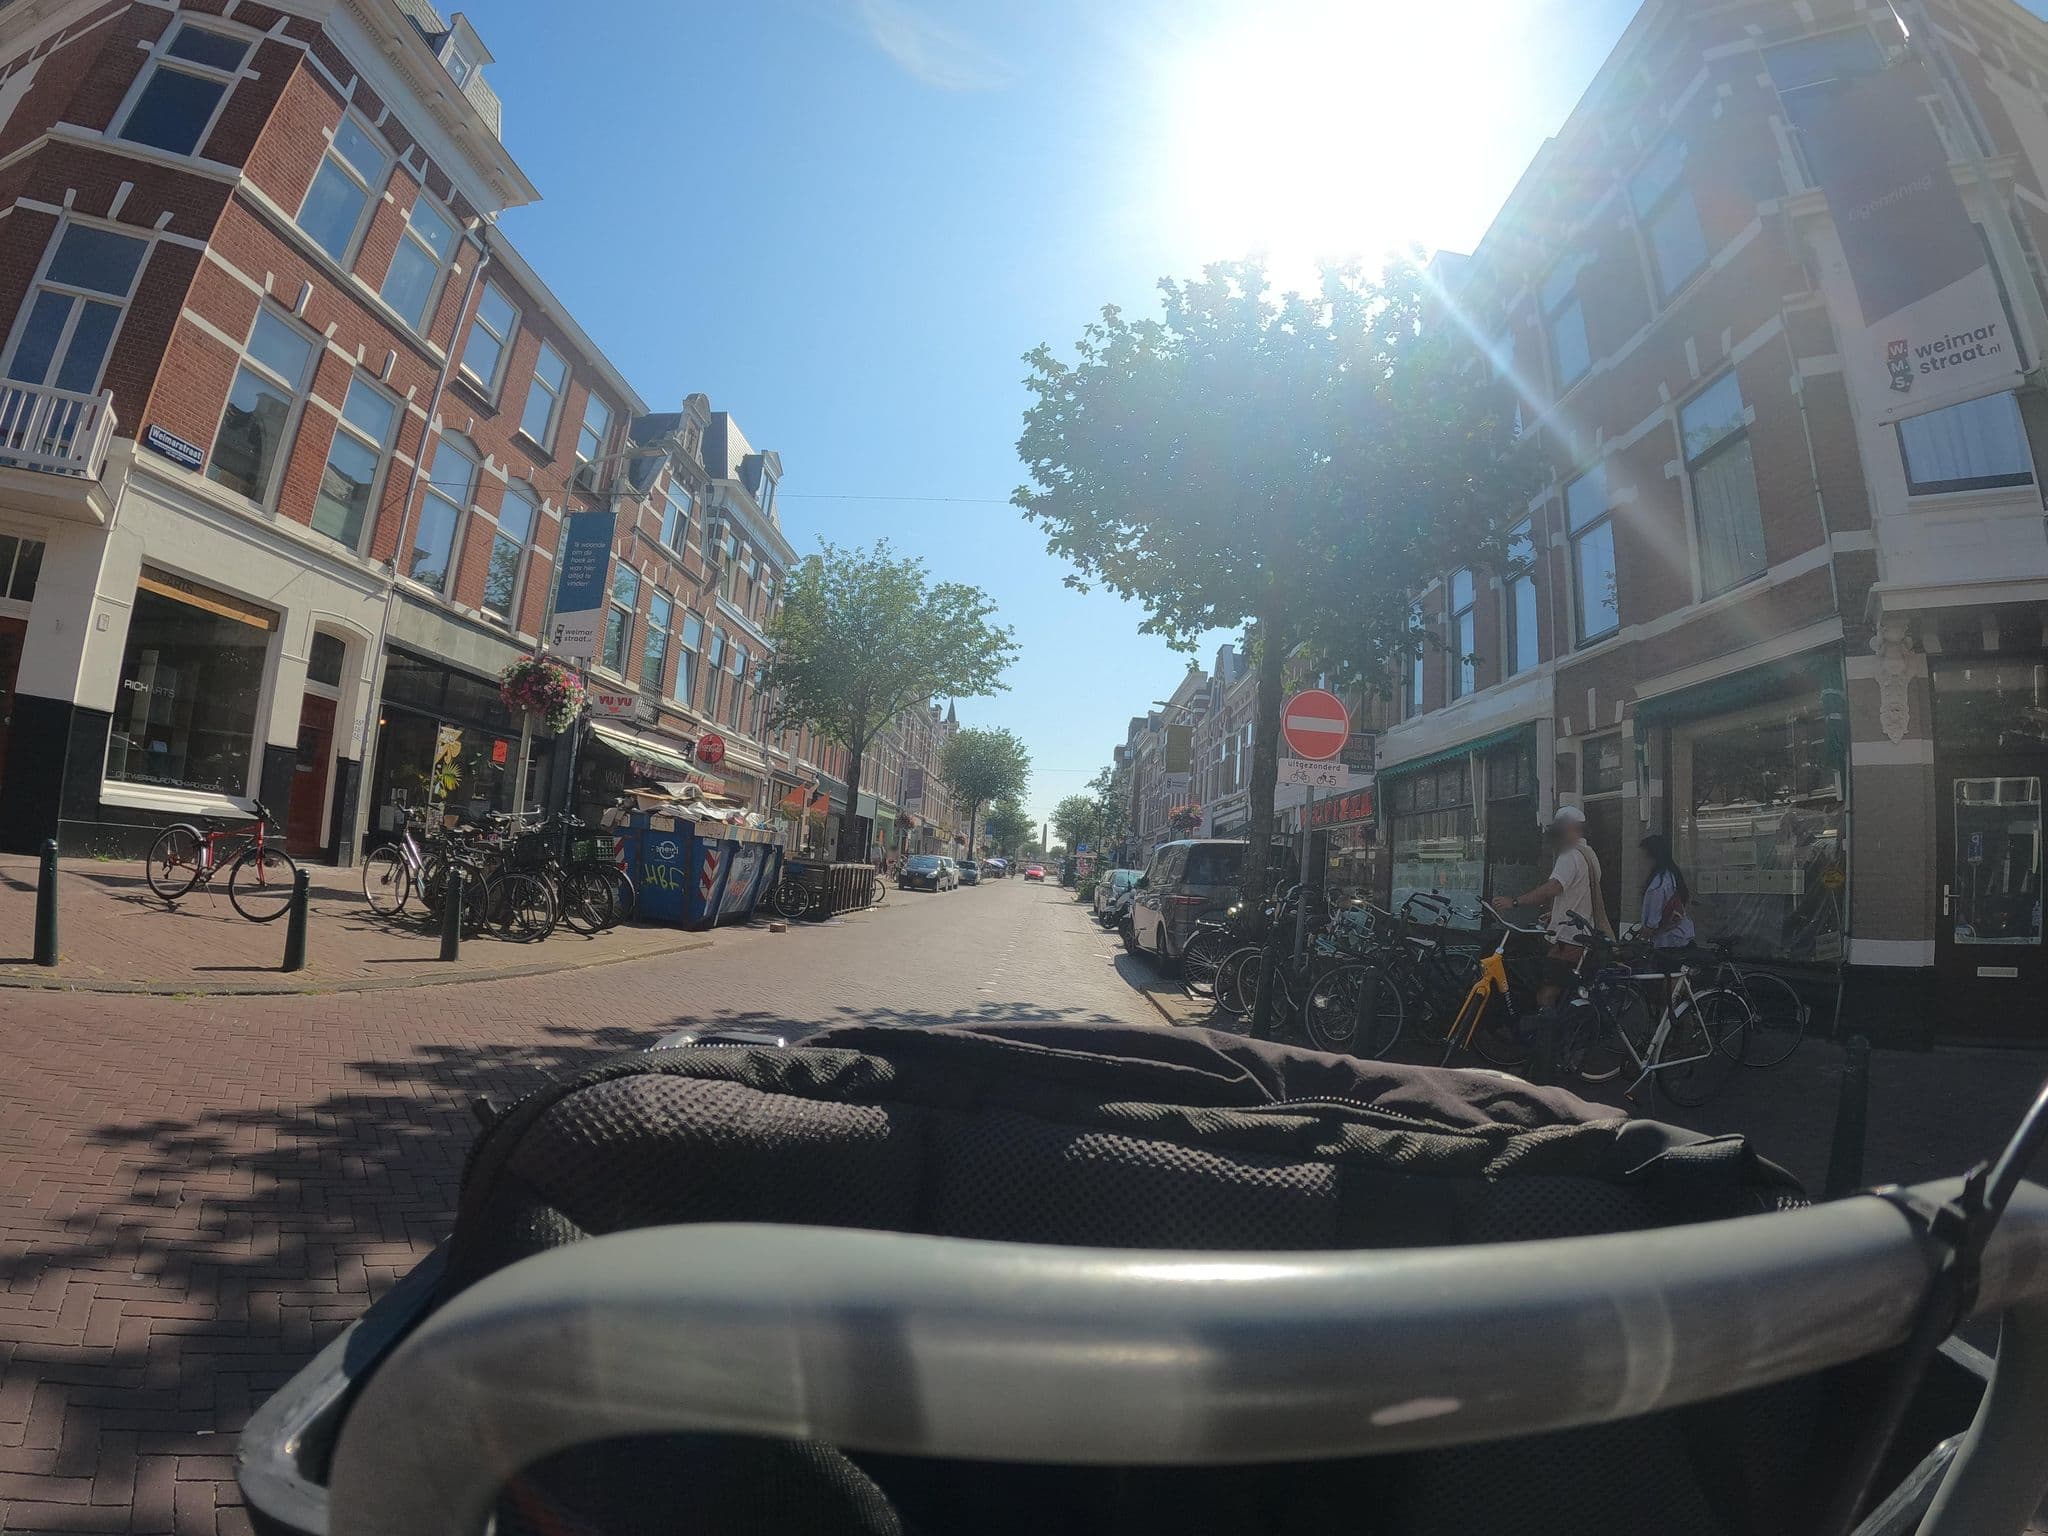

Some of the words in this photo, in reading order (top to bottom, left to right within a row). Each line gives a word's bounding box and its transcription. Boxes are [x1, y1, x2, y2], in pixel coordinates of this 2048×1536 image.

[1914, 322, 1997, 359] weimar
[1919, 343, 2001, 375] straat.nl
[152, 428, 202, 460] Weimarstraat
[564, 629, 593, 637] weimar
[1288, 761, 1341, 772] uitgezonderd
